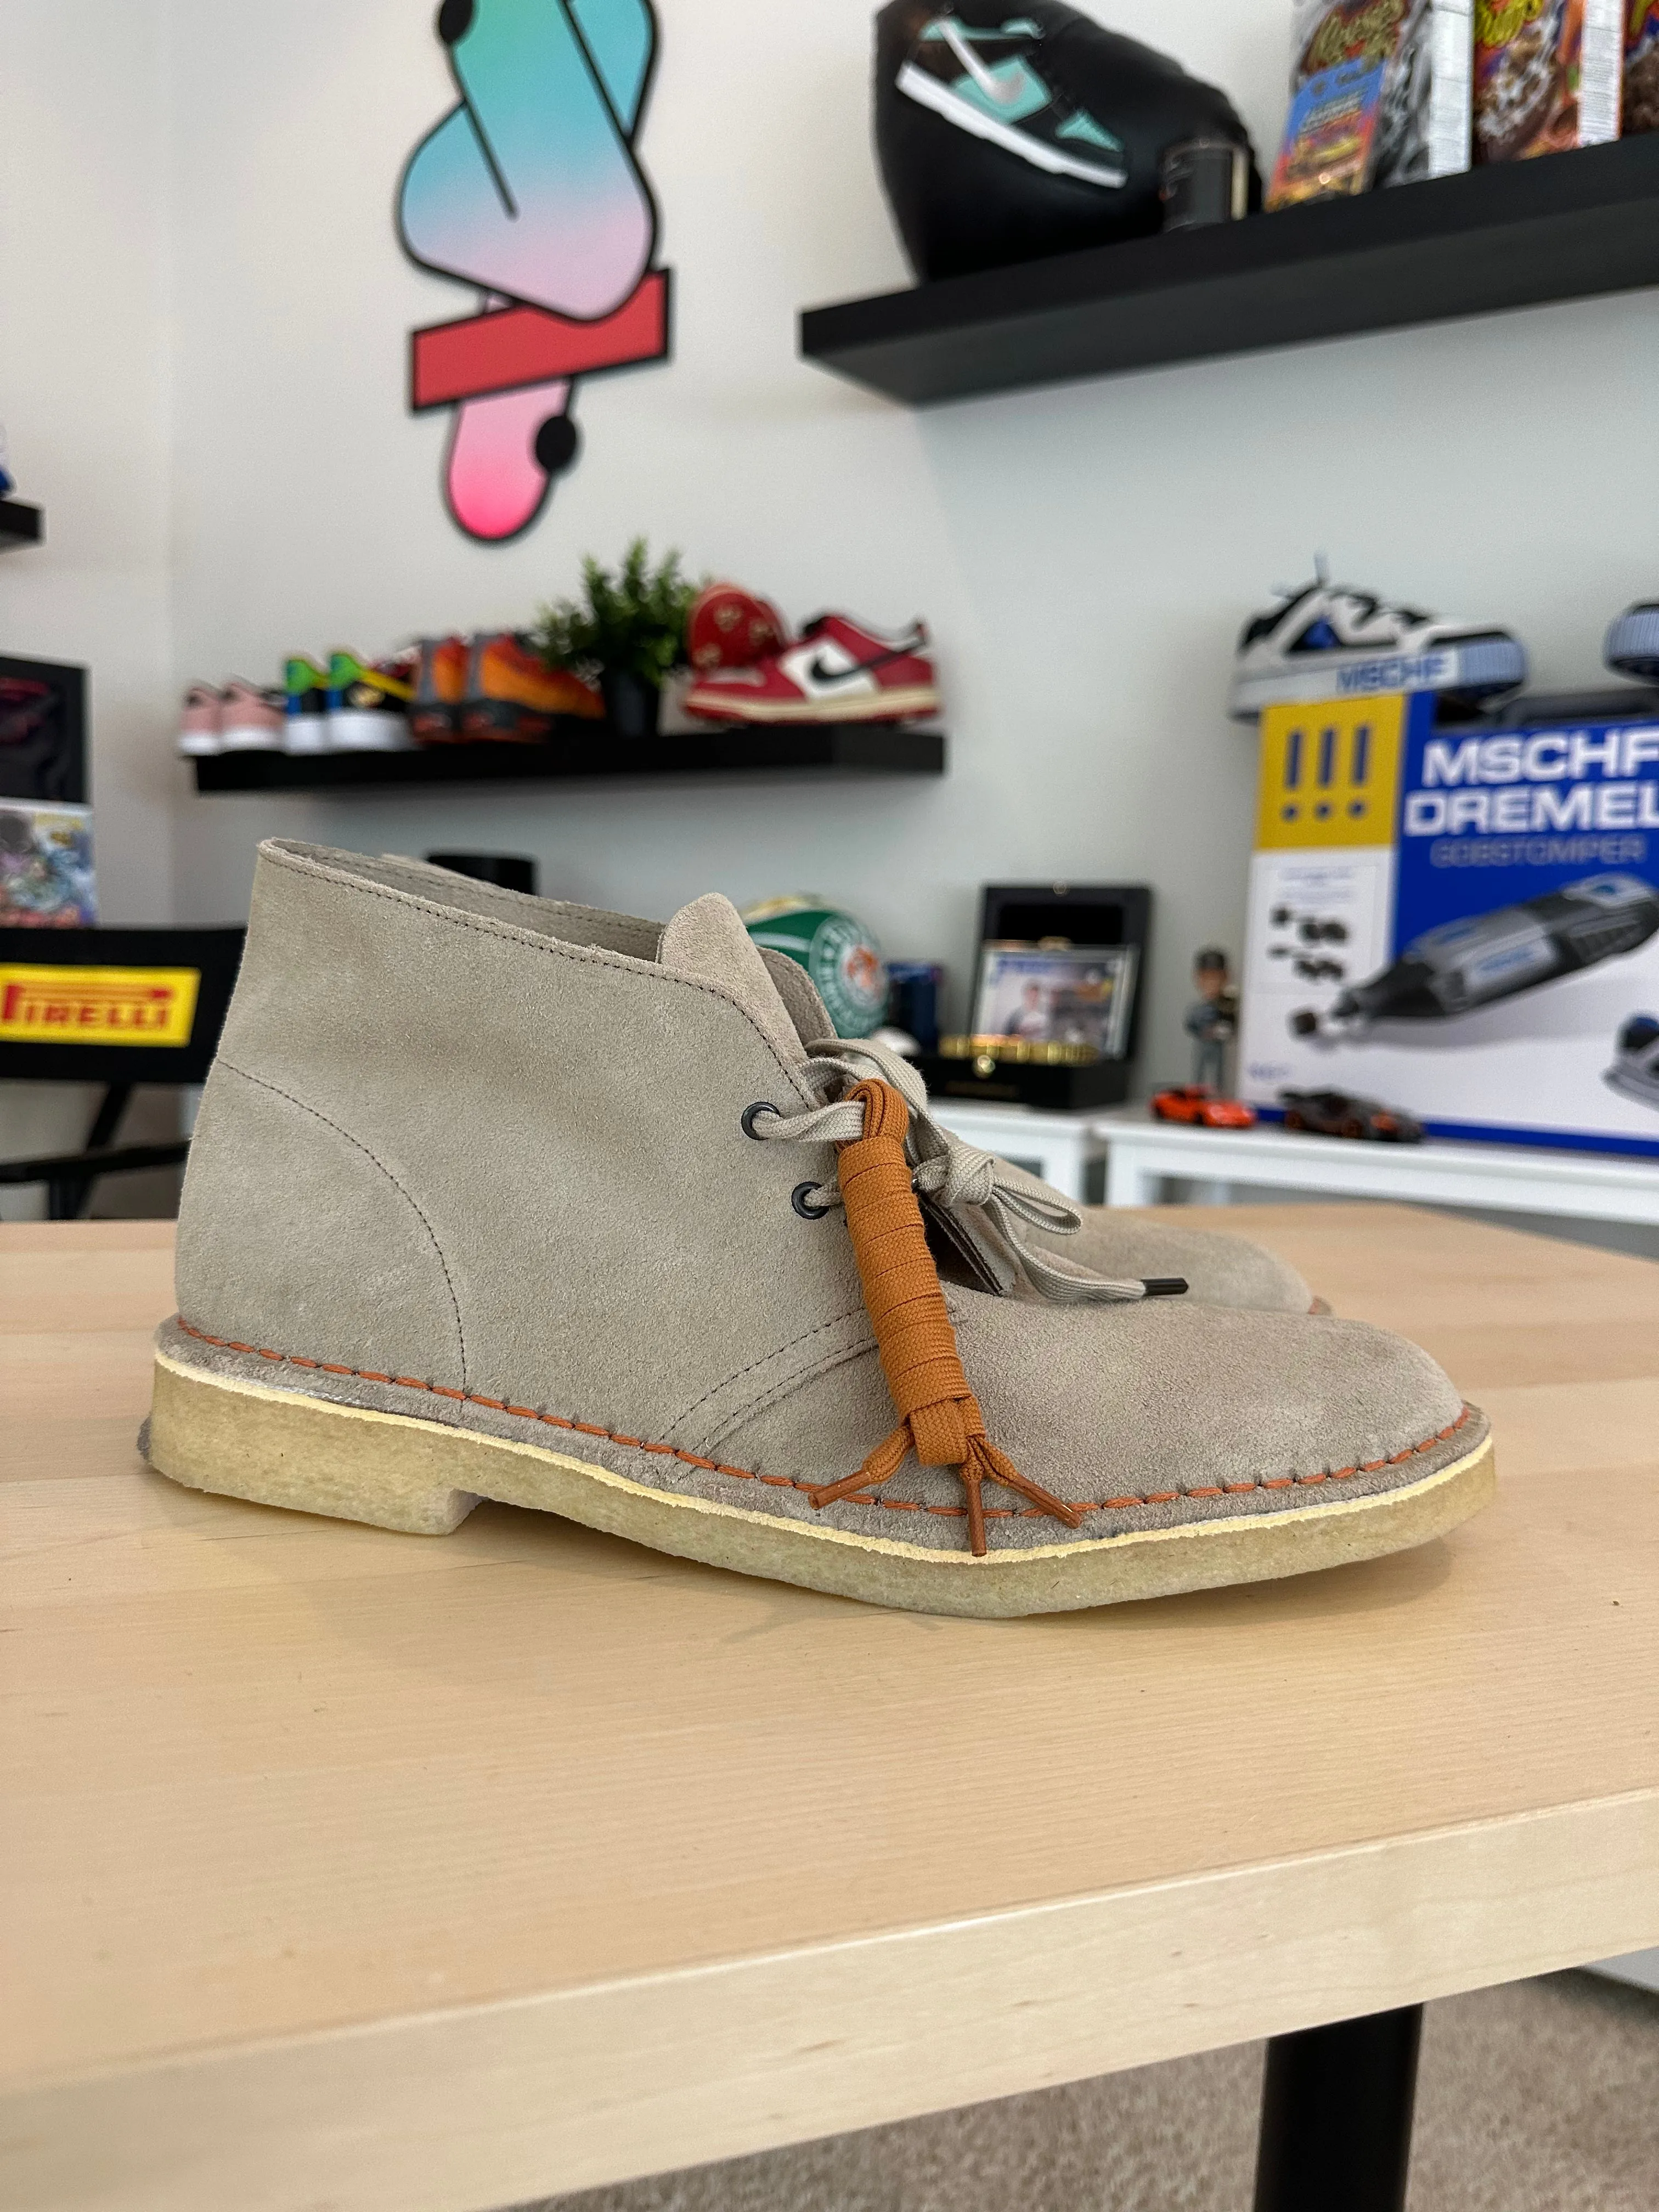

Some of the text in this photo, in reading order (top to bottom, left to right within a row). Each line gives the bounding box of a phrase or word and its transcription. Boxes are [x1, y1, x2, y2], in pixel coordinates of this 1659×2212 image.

[1336, 656, 1446, 692] MSCHF
[1422, 727, 1659, 787] MSCHF
[1, 983, 172, 1028] PIRELLI
